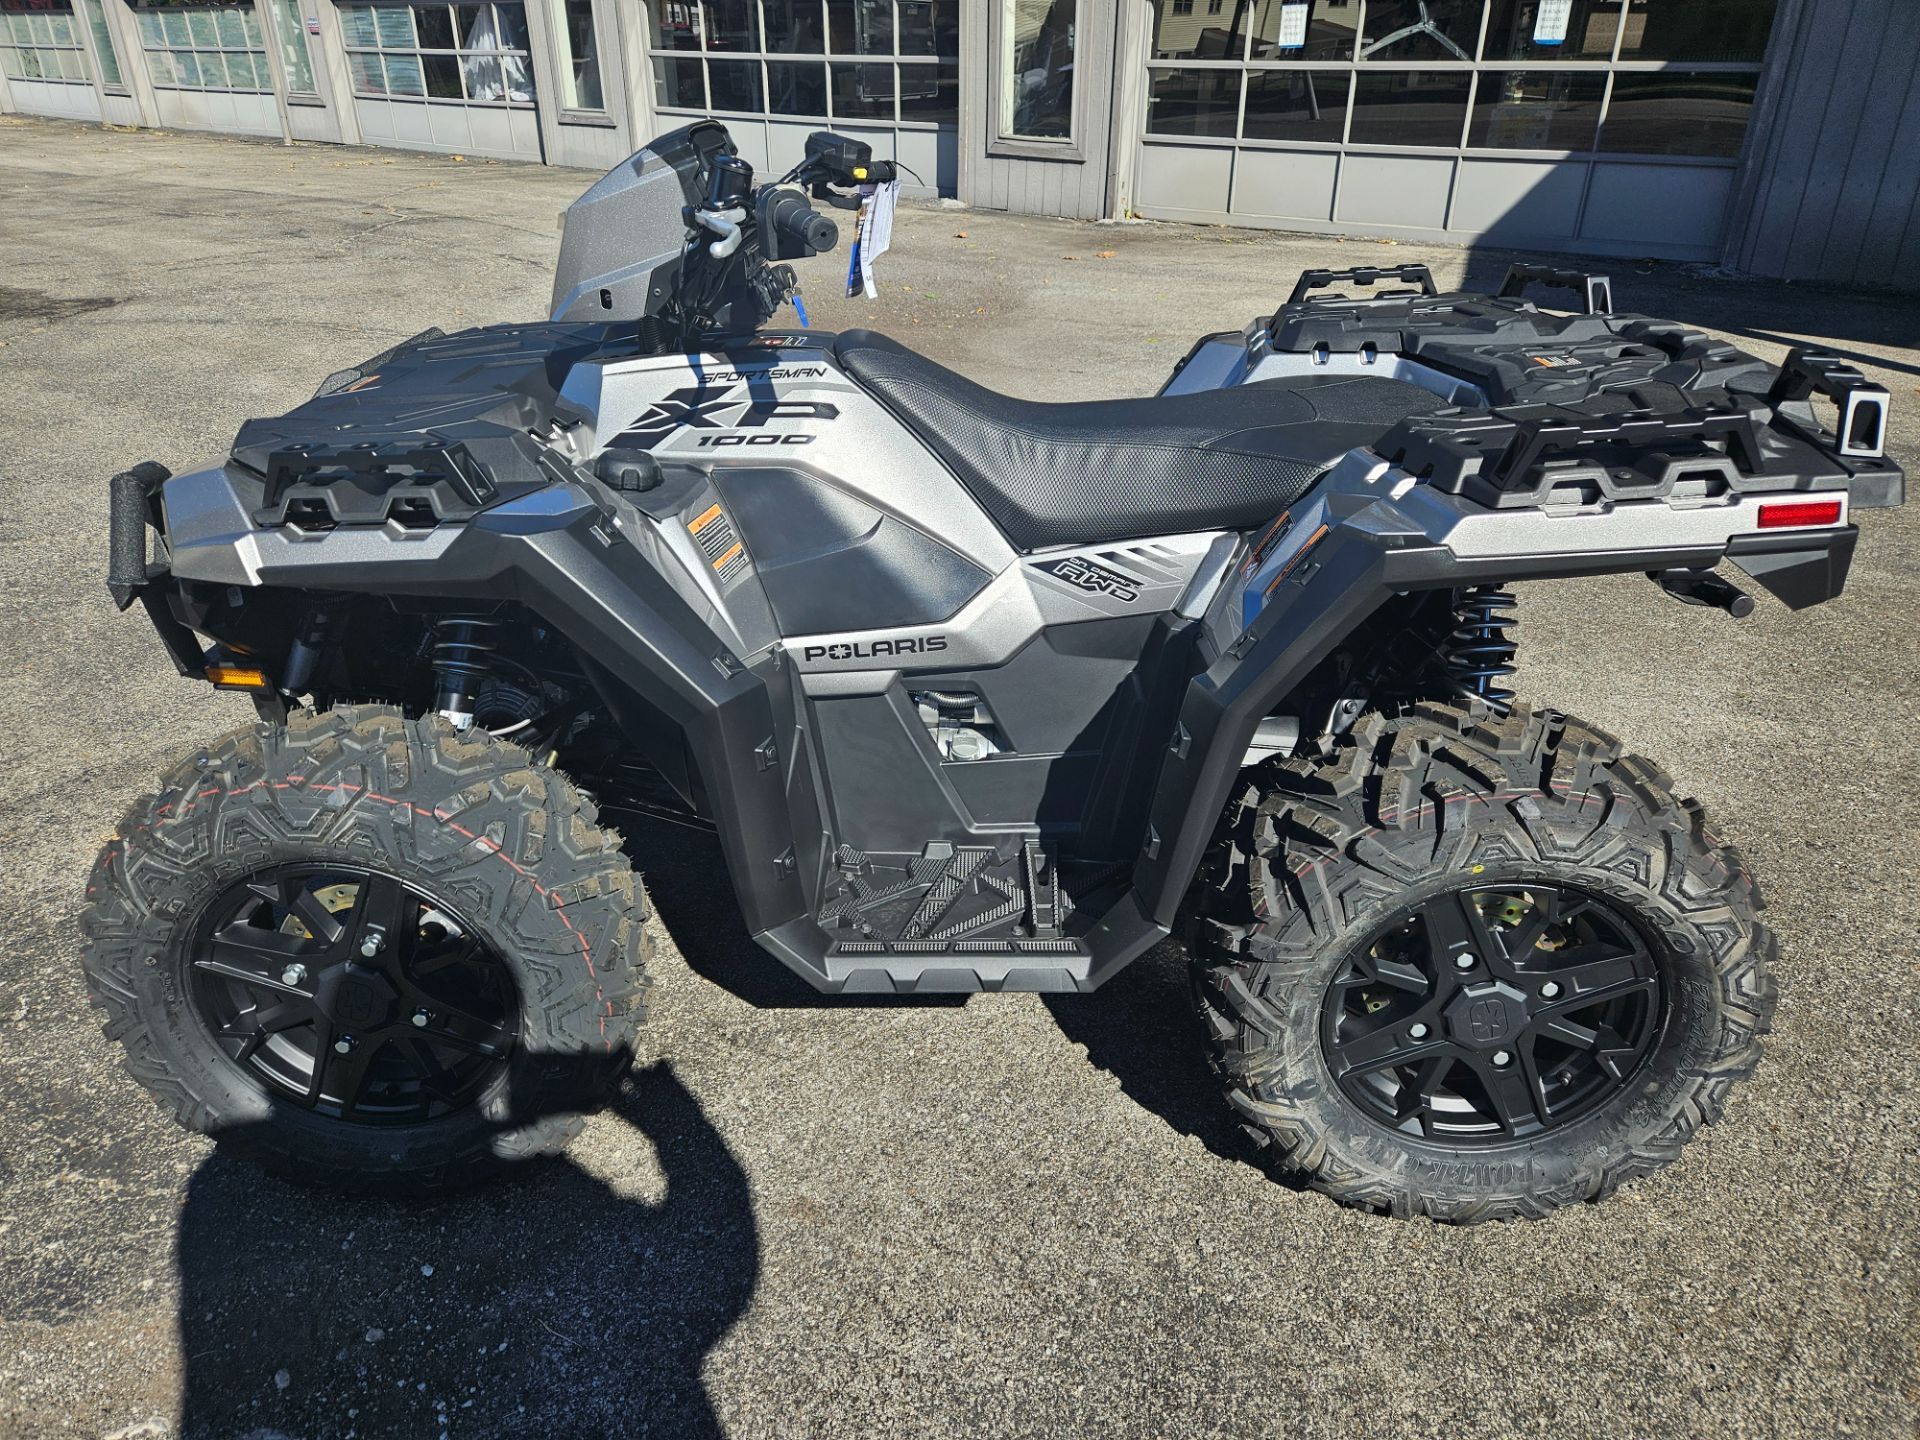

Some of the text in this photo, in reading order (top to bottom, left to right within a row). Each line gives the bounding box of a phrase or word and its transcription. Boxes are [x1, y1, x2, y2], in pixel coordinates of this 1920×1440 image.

[700, 367, 827, 384] SPORTSMAN
[602, 385, 840, 449] XP
[697, 434, 817, 447] 1000
[1068, 557, 1088, 568] ON
[1052, 561, 1140, 604] AWD
[804, 635, 949, 662] POLARIS
[1567, 872, 1698, 955] DURO
